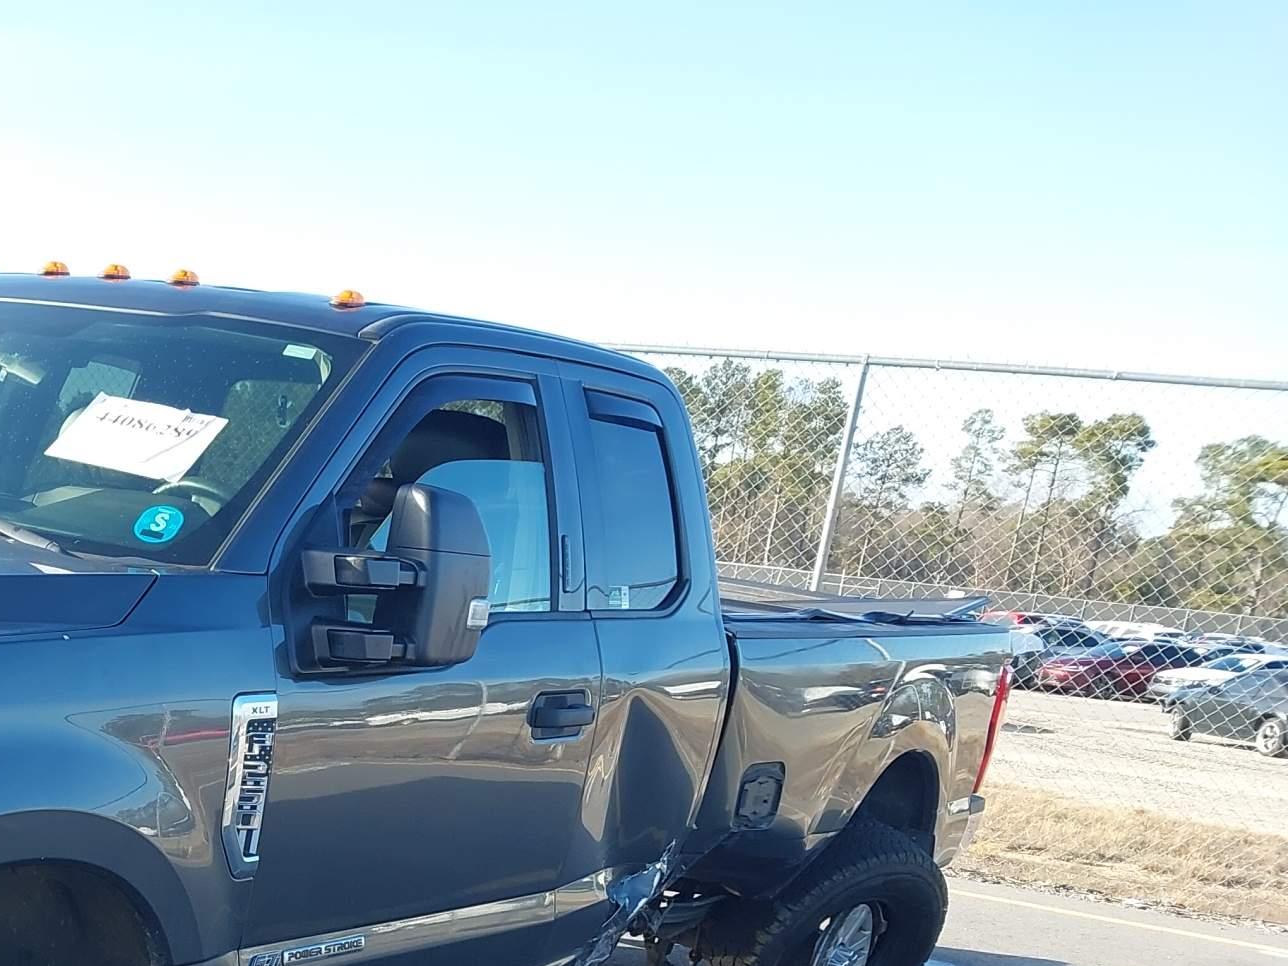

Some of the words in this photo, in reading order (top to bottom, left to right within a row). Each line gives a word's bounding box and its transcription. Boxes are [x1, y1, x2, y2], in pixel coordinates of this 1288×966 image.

[251, 705, 271, 715] XLT
[287, 947, 323, 962] POWER
[323, 938, 364, 955] STROKE
